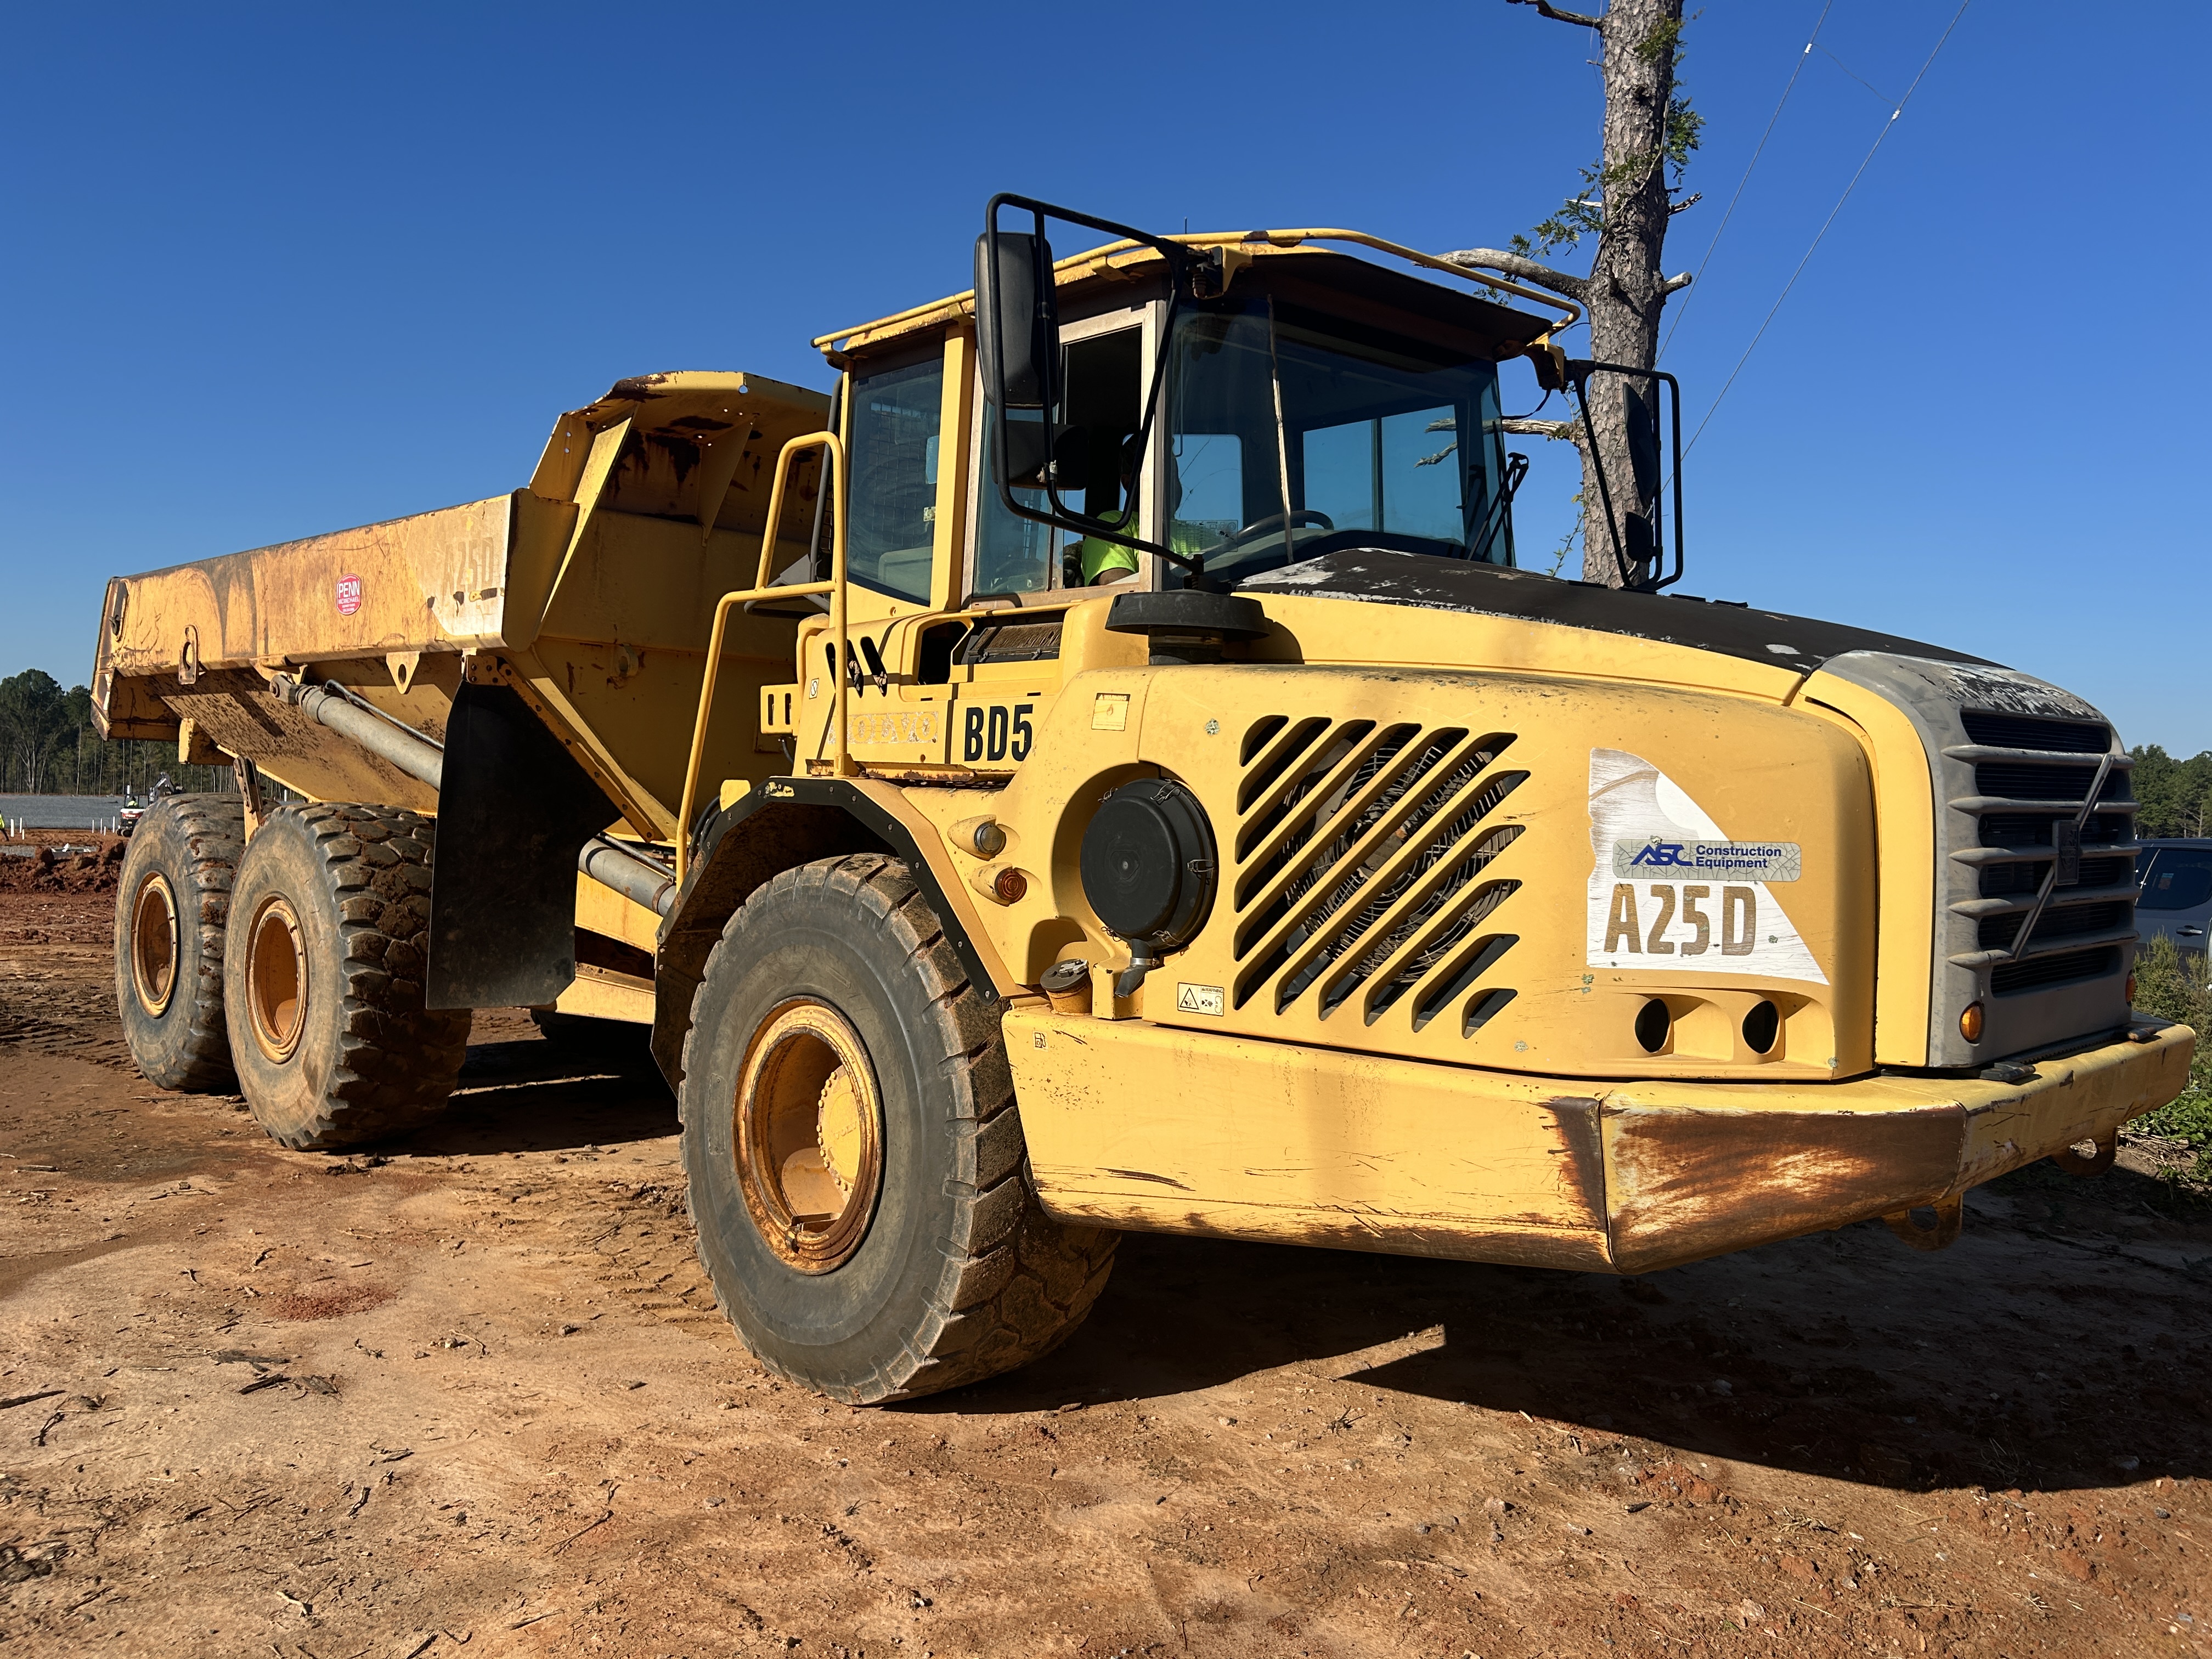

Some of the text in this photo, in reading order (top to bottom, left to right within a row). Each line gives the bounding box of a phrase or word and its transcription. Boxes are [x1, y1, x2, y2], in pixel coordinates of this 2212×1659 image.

[338, 580, 360, 599] PENN
[833, 713, 936, 742] OLVO
[964, 704, 1033, 762] BD5
[1696, 845, 1781, 857] Construction
[1696, 857, 1768, 869] Equipment
[1604, 884, 1756, 956] A25D
[833, 1121, 857, 1140] VOLV
